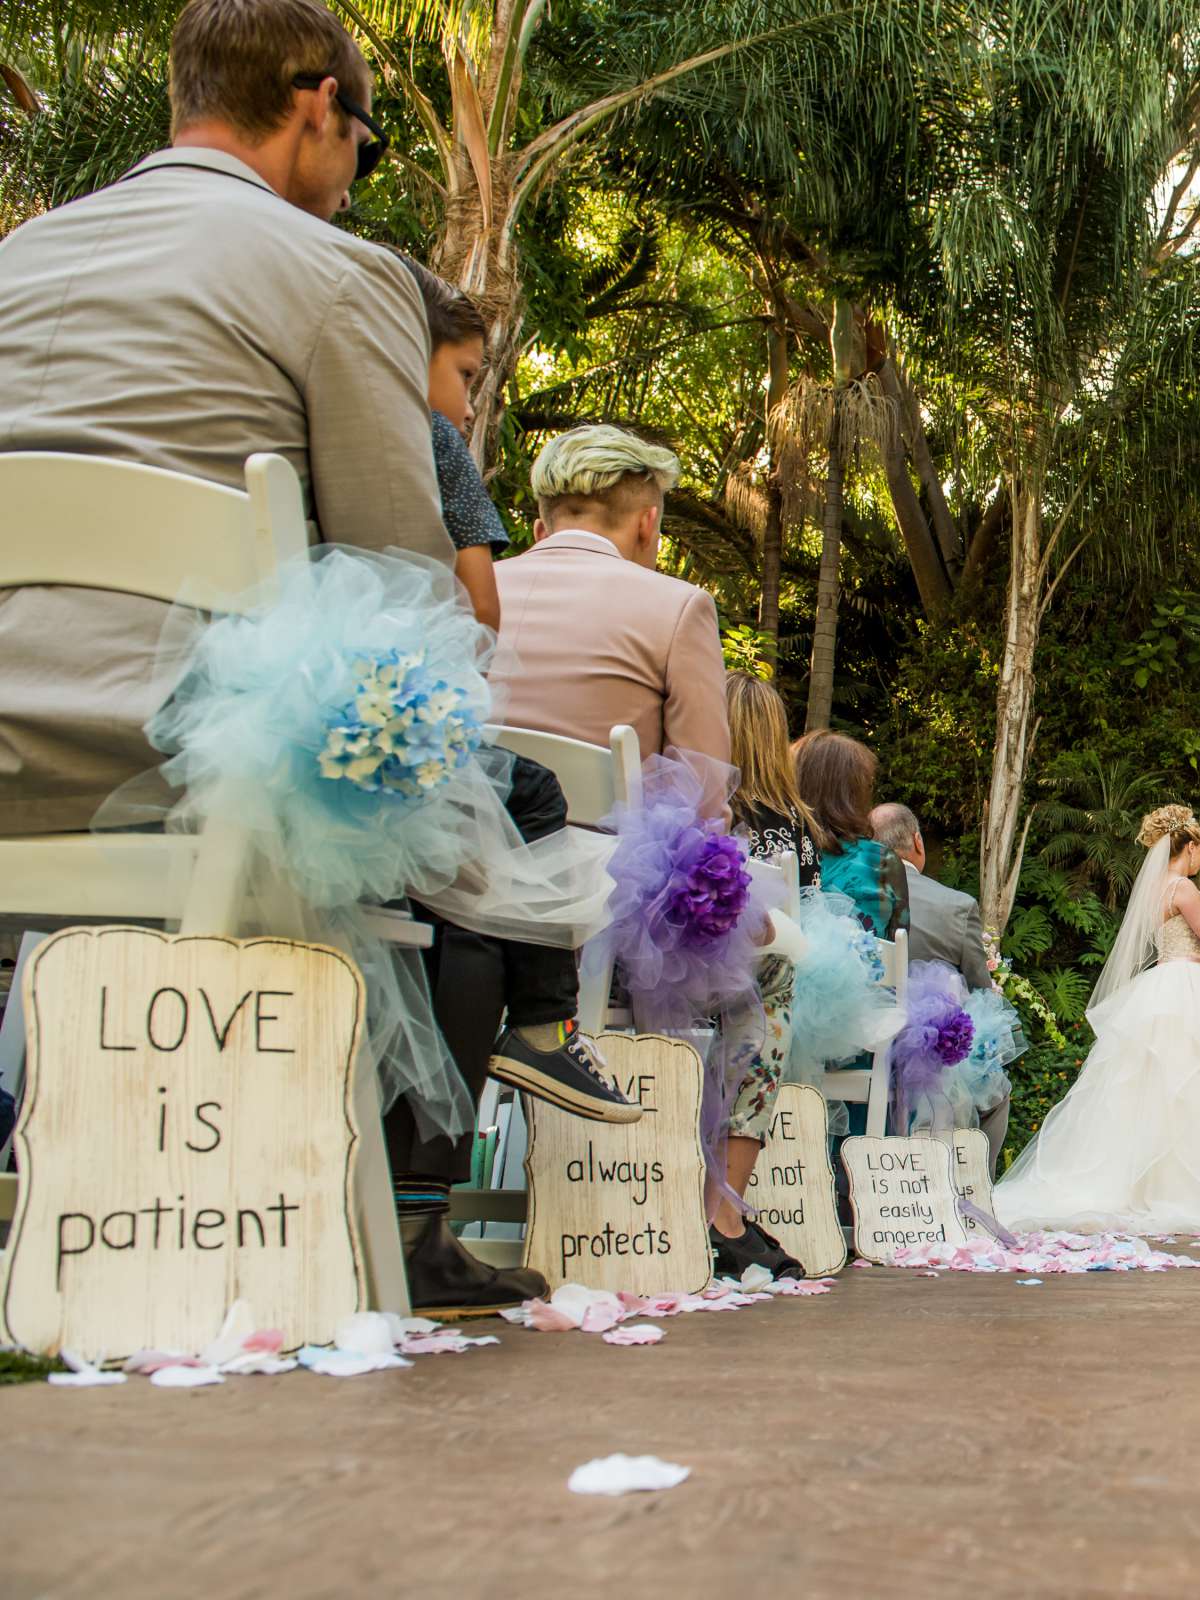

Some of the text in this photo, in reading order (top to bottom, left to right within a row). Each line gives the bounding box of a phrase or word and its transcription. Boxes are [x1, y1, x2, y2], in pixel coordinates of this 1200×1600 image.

[100, 986, 296, 1053] LOVE
[611, 1074, 659, 1112] VE
[158, 1086, 223, 1153] is
[767, 1111, 797, 1140] VE
[566, 1140, 665, 1205] always
[771, 1159, 806, 1187] not
[866, 1153, 926, 1172] LOVE
[871, 1175, 931, 1195] is not
[879, 1200, 934, 1224] easily
[56, 1193, 300, 1292] patient
[561, 1222, 672, 1279] protects
[873, 1223, 946, 1249] angered
